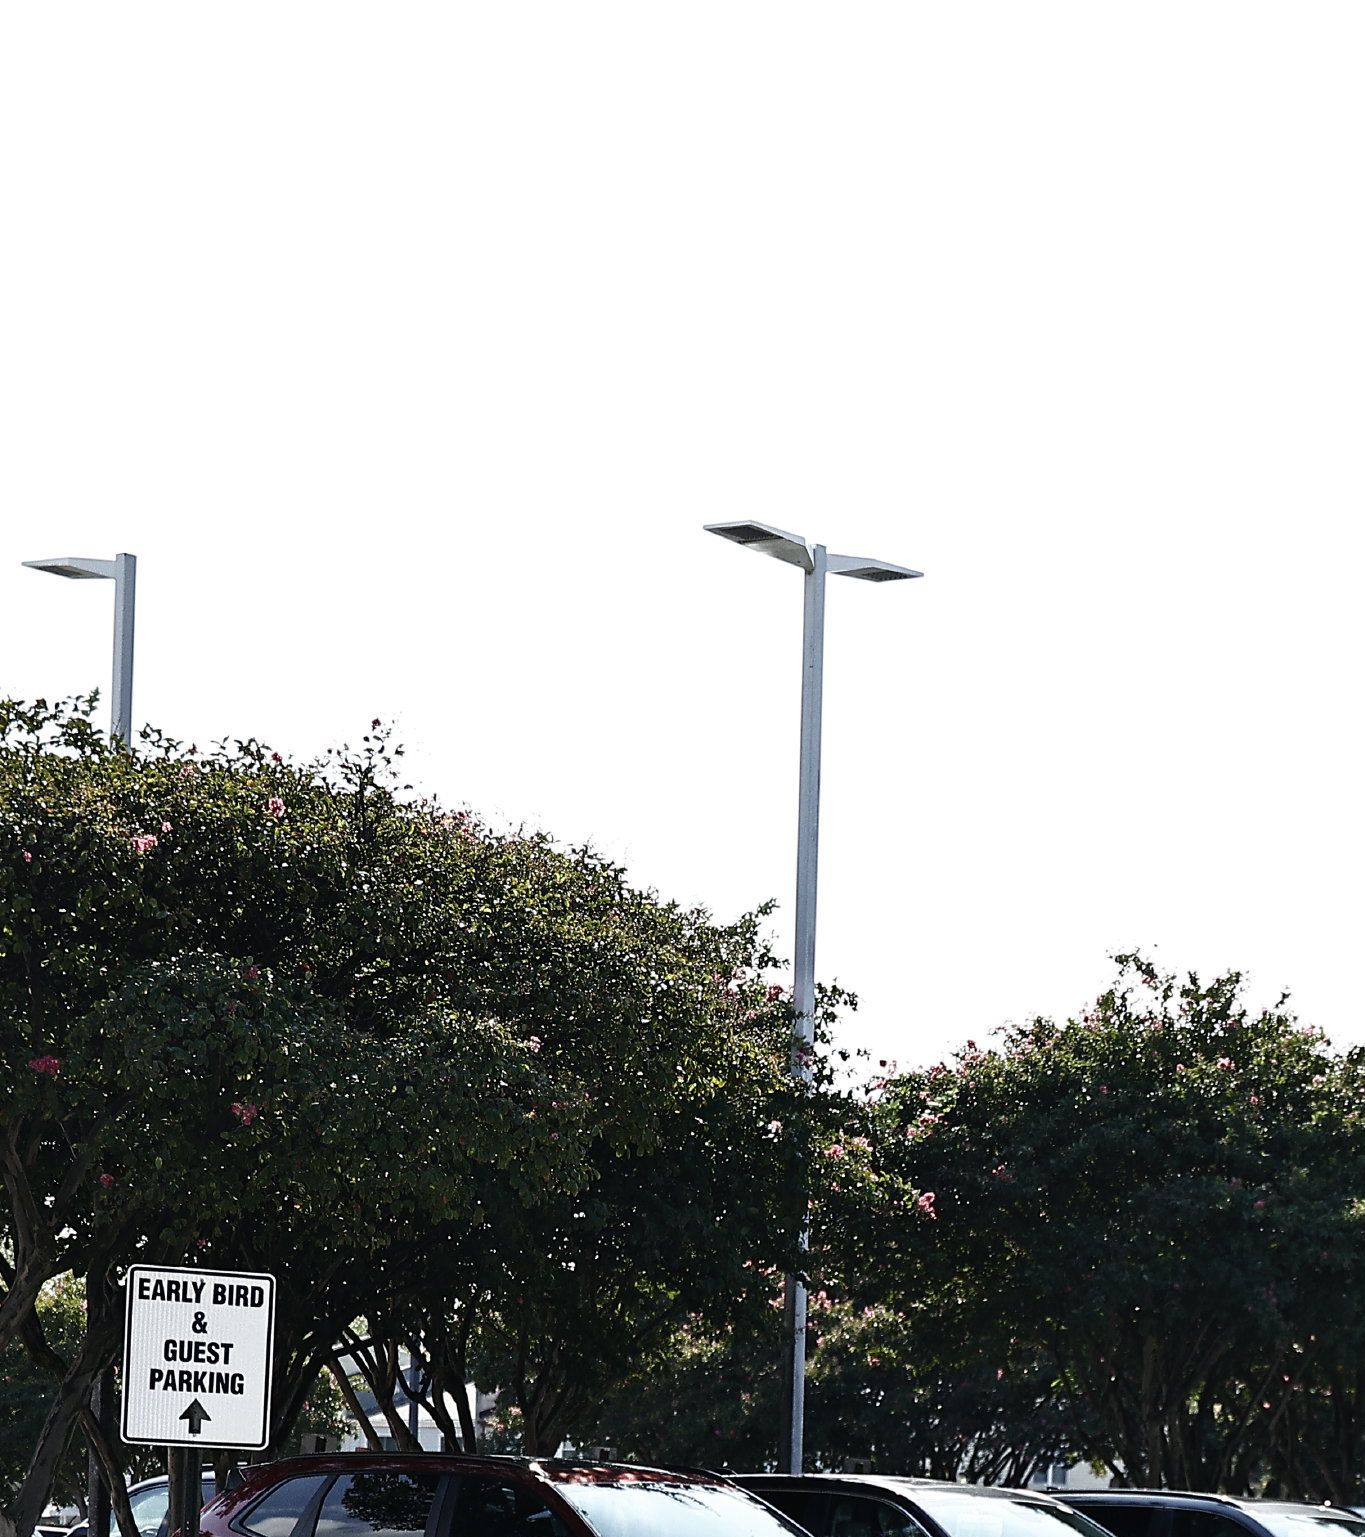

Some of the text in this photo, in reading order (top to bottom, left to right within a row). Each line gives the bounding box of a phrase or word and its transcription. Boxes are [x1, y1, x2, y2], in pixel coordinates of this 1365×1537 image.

[138, 1277, 265, 1308] EARLY BIRD
[191, 1311, 208, 1334] &
[163, 1338, 234, 1365] GUEST
[149, 1368, 245, 1395] PARKING
